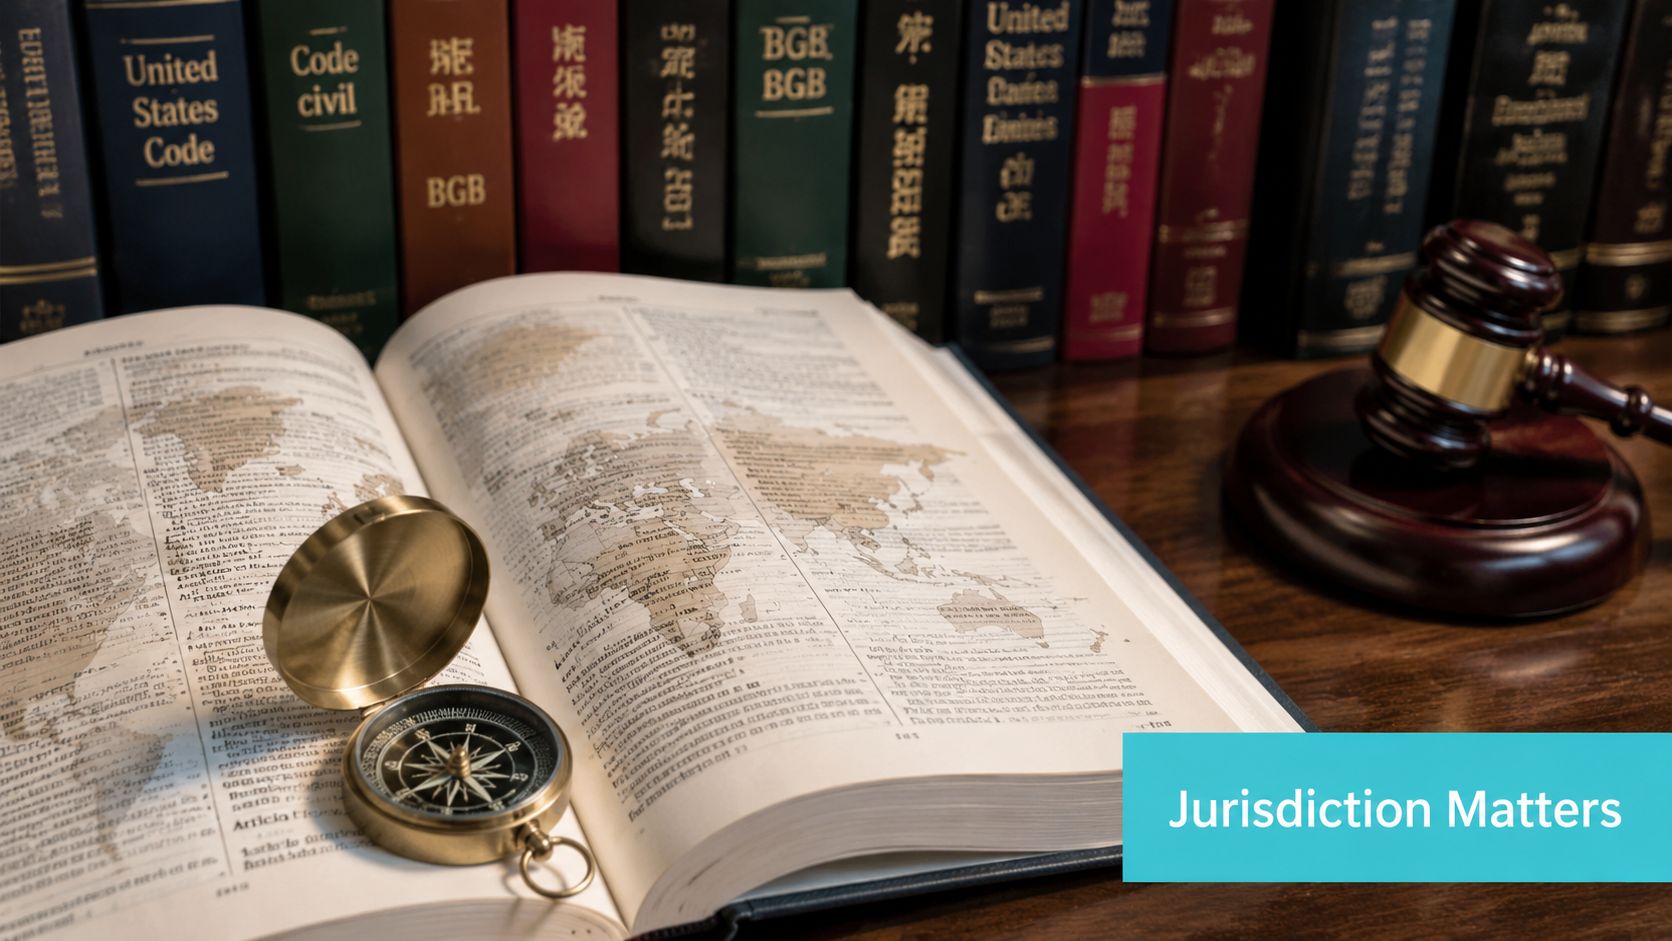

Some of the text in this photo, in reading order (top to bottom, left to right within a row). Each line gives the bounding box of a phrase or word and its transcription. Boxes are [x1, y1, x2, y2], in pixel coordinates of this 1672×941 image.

[986, 1, 1071, 34] United
[123, 50, 219, 87] United
[290, 41, 360, 77] Code
[984, 39, 1065, 71] States
[297, 82, 357, 118] civil
[762, 66, 828, 101] BGB
[132, 96, 219, 129] States
[143, 133, 216, 169] Code
[426, 173, 487, 208] BGB
